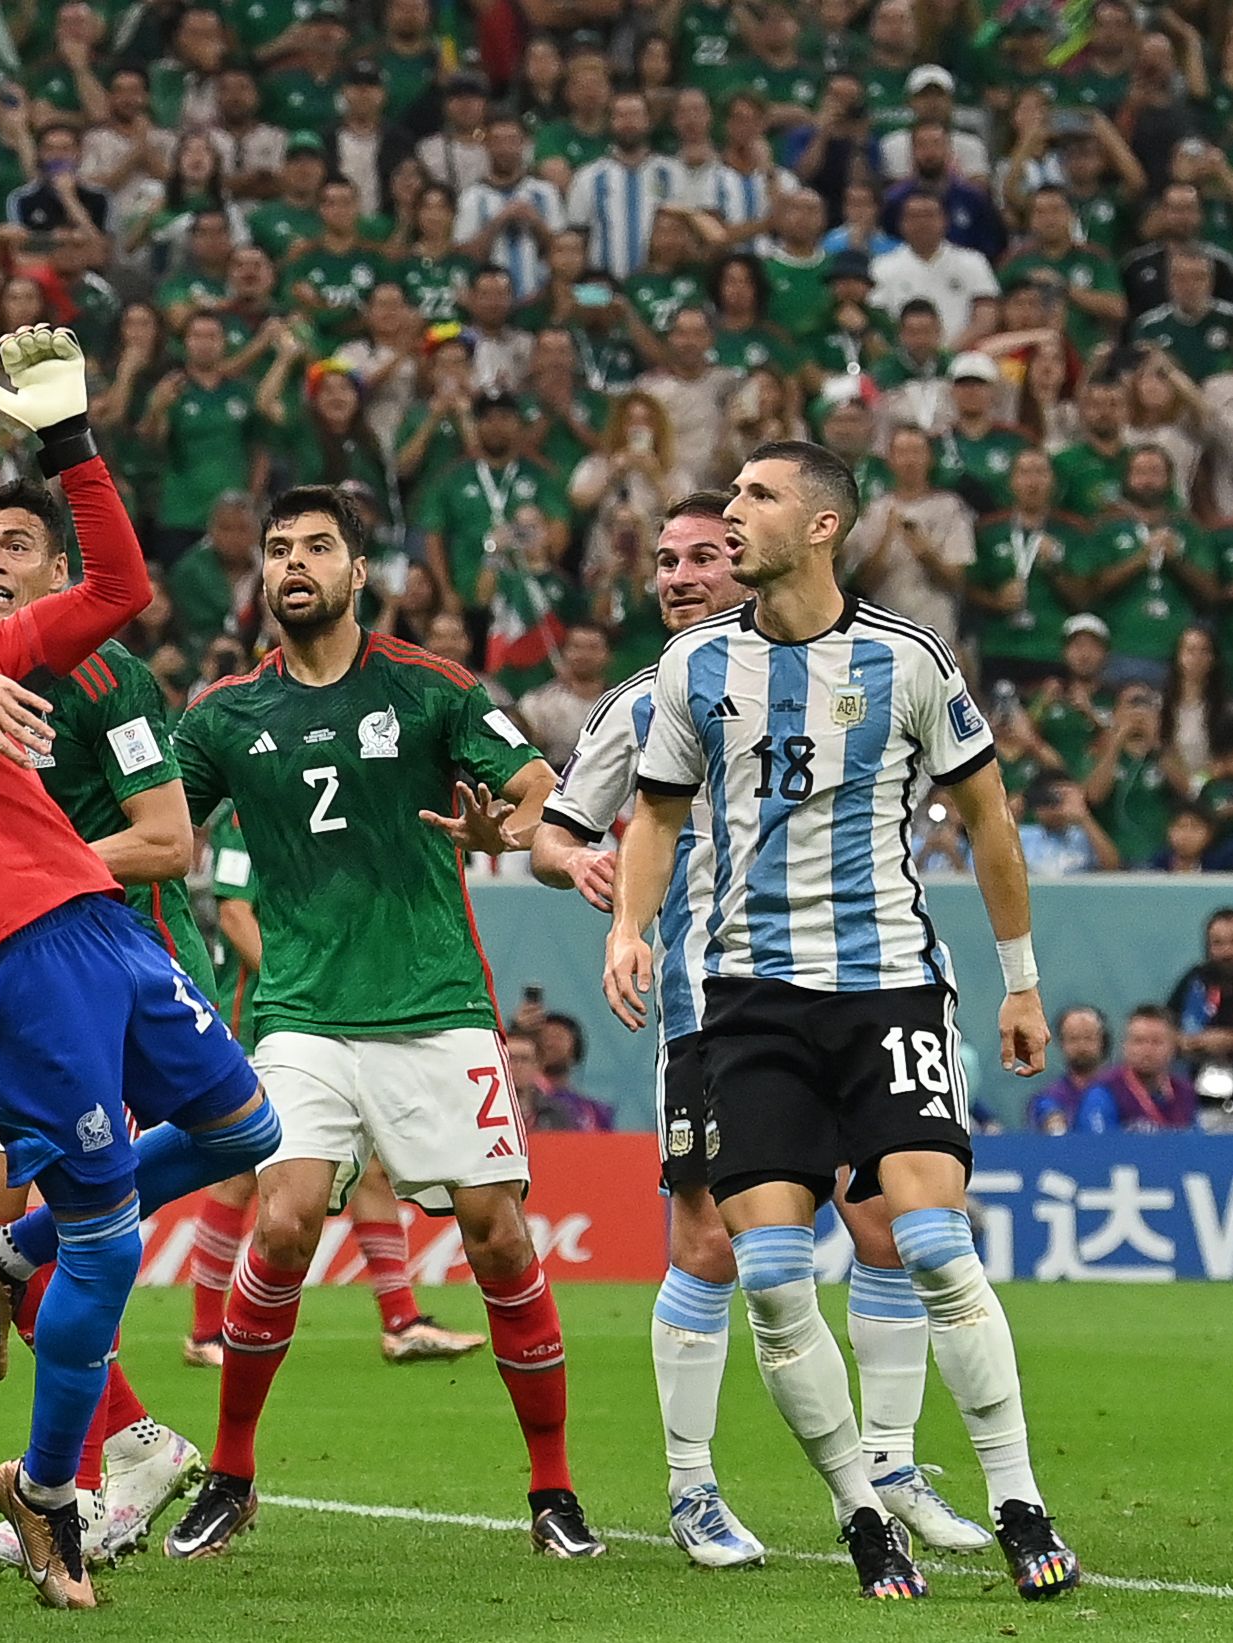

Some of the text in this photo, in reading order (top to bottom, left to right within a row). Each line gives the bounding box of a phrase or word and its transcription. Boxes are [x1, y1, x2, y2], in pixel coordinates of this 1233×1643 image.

[303, 765, 348, 834] 2
[750, 735, 816, 801] 18
[880, 1026, 950, 1095] 18
[467, 1066, 510, 1130] 2
